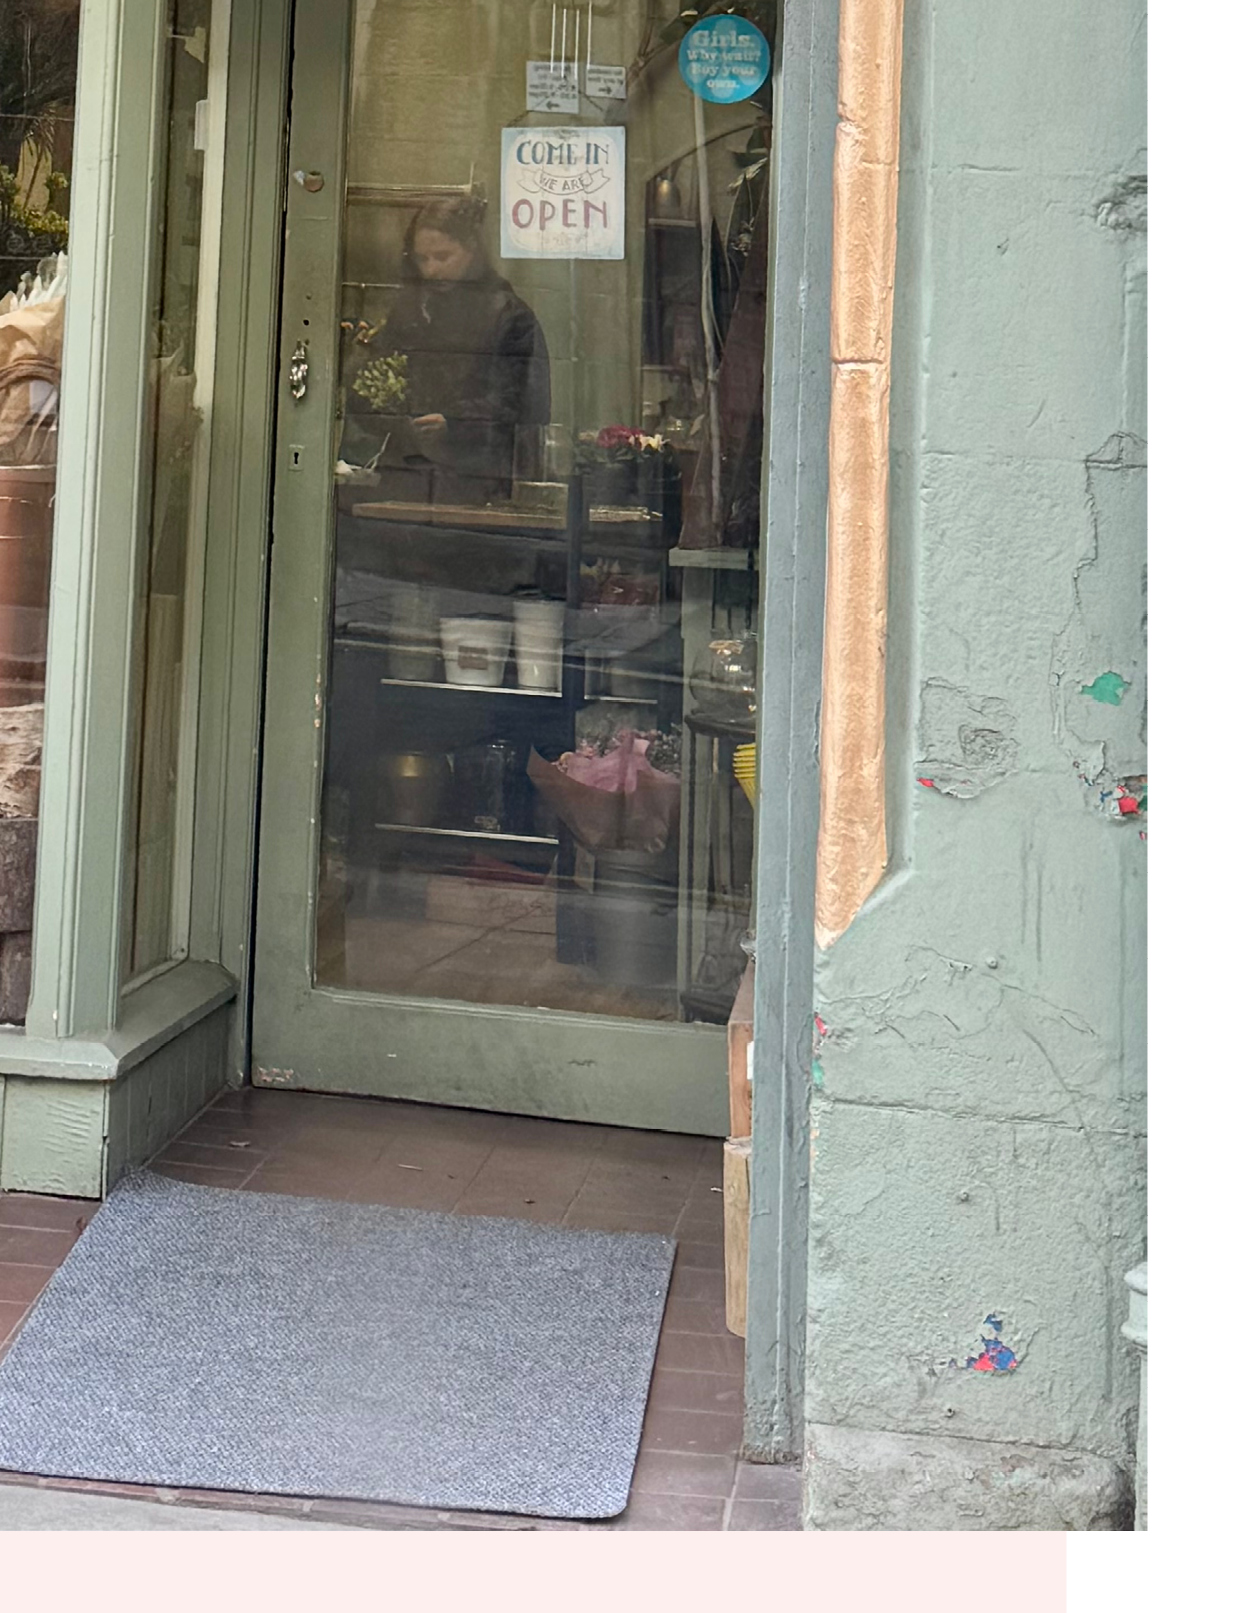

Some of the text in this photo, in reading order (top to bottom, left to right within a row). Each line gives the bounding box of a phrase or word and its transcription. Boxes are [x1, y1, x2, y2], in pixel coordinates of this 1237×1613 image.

[516, 139, 610, 166] COME IN
[540, 176, 585, 192] WE ARE
[512, 197, 608, 231] OPEN
